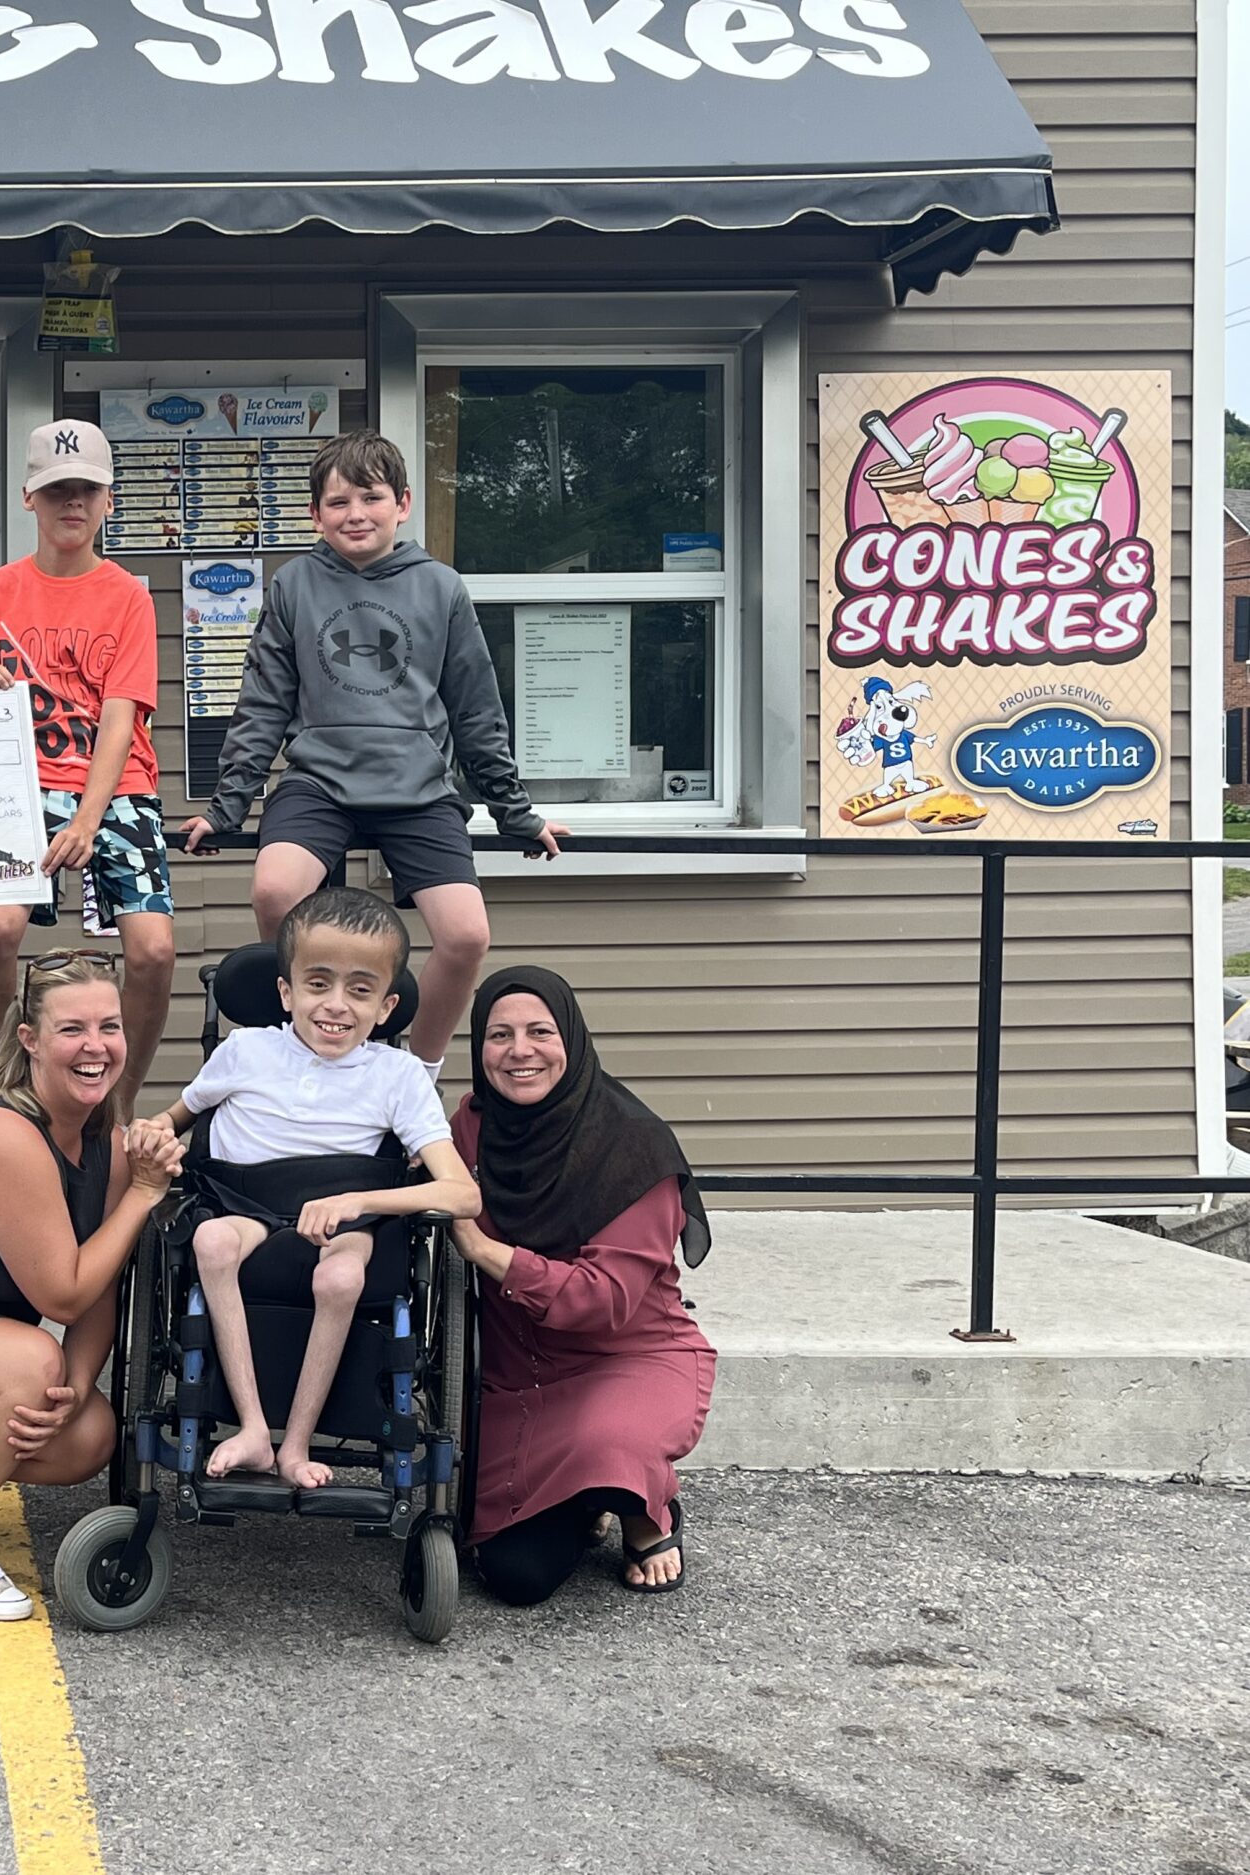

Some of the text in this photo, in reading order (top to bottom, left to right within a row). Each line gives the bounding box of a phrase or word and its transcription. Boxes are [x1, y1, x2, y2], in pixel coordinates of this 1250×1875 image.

[135, 0, 931, 84] Shakes
[151, 401, 200, 418] Kawartha
[246, 398, 303, 411] Ice Cream
[243, 411, 306, 427] Flavours!
[843, 527, 1148, 587] CONES &
[194, 573, 251, 588] Kawartha
[347, 600, 387, 613] UNDER
[200, 612, 247, 622] Ice Cream
[834, 590, 1150, 654] SHAKES
[317, 608, 344, 648] ARMOUR
[386, 609, 414, 651] ARMOUR
[998, 683, 1113, 713] PROUDLY SERVING
[1022, 717, 1090, 736] EST. 1937
[890, 742, 906, 758] S
[971, 737, 1141, 776] Kawartha
[1023, 778, 1088, 796] DAIRY
